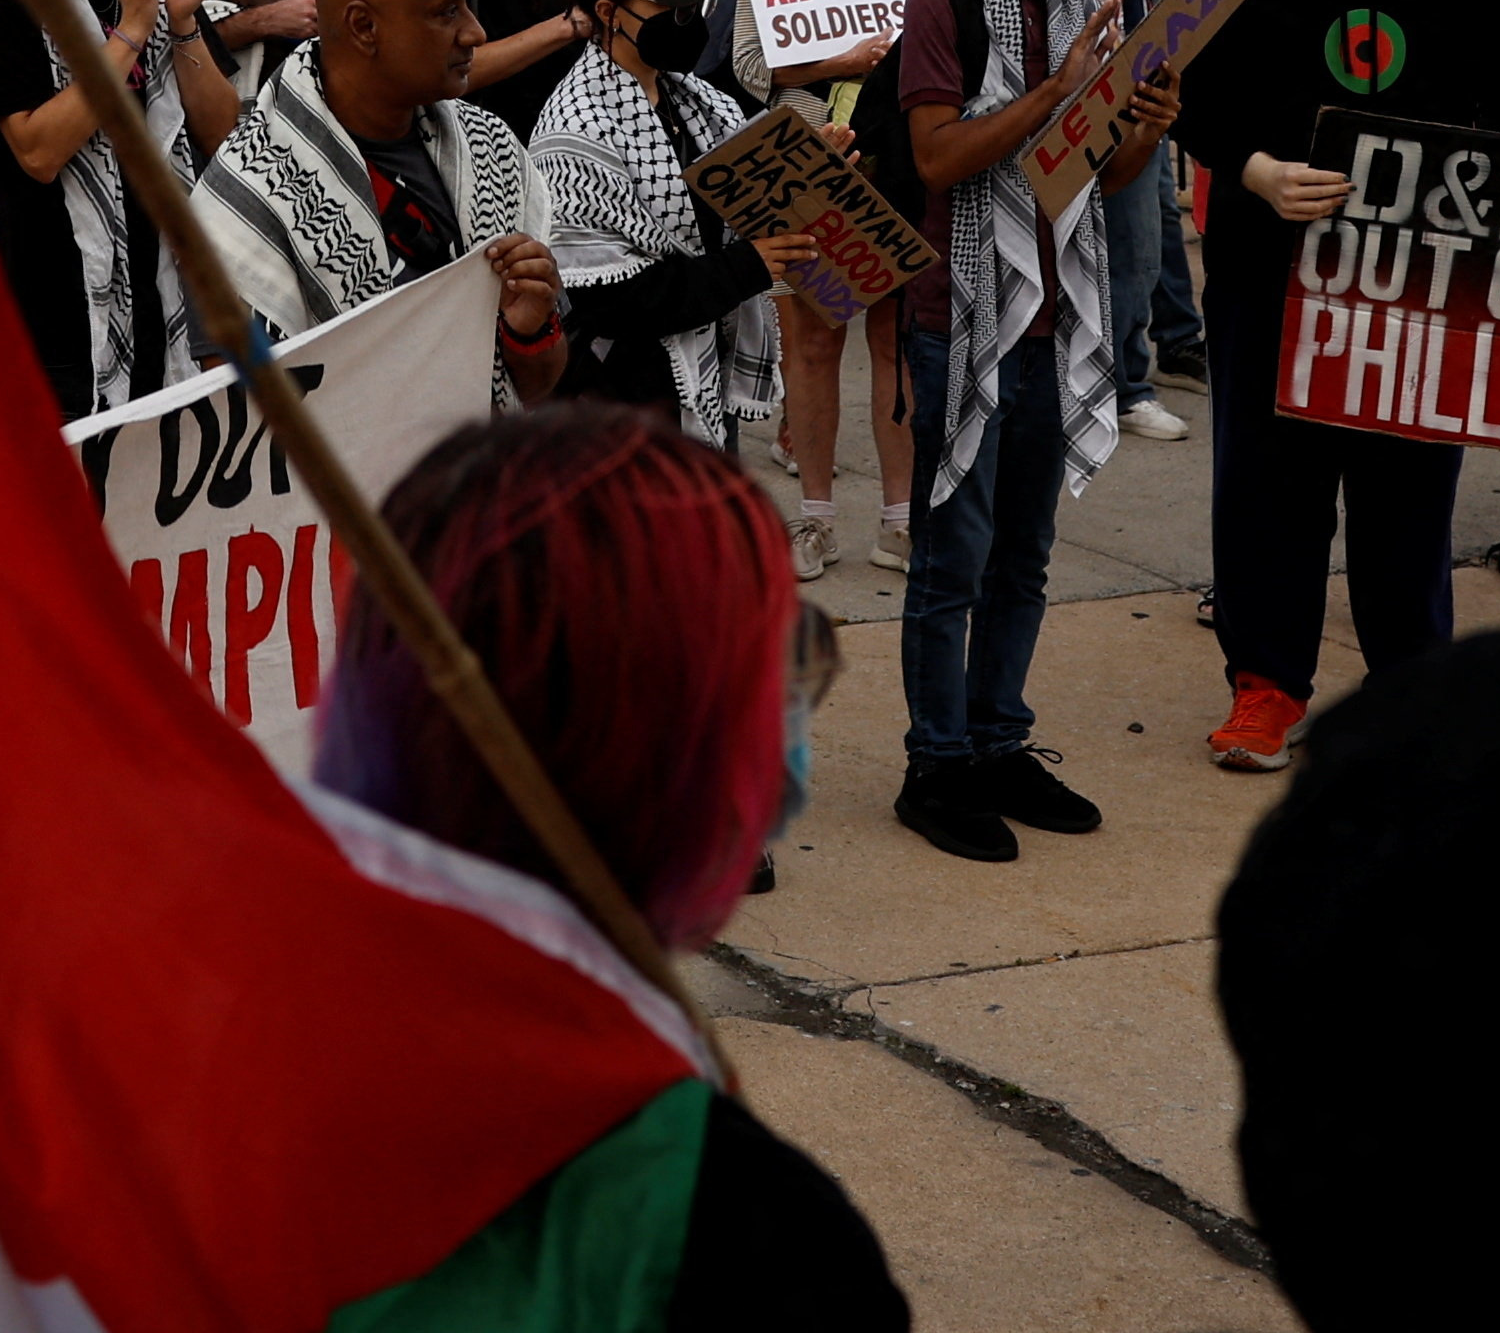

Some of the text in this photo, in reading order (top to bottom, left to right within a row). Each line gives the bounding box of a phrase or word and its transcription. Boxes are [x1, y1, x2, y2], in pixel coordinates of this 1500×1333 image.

[771, 0, 906, 49] SOLDIERS
[762, 116, 933, 273] NETANYAHU
[1035, 66, 1115, 176] LET
[697, 164, 868, 322] ON HIS ANDS
[731, 144, 895, 294] HAS BLOOD
[1298, 217, 1473, 311] OUT
[131, 523, 358, 729] MPI
